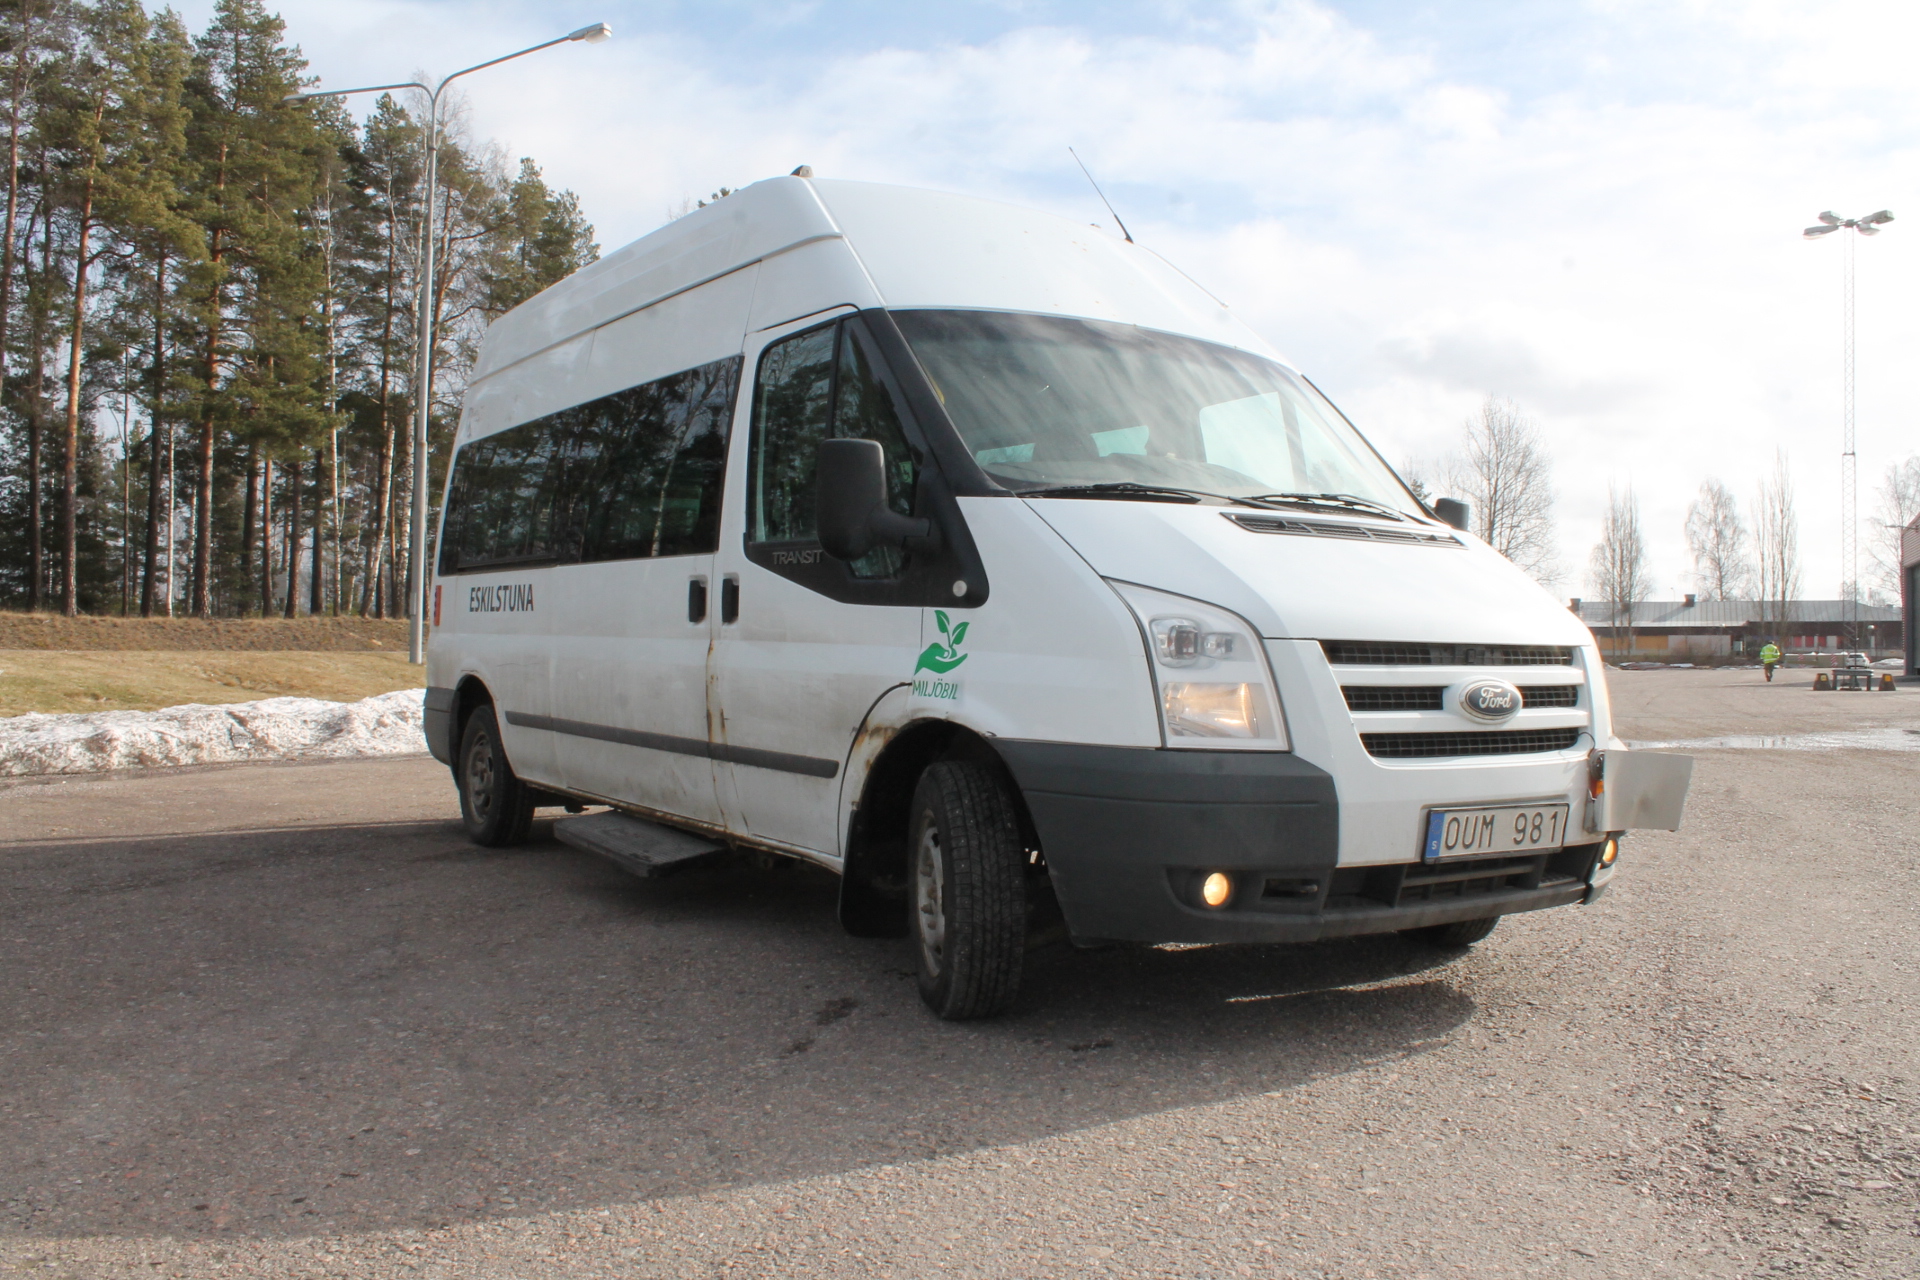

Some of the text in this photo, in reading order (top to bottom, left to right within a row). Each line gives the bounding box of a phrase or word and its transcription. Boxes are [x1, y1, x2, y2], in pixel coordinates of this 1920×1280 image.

[772, 550, 823, 565] TRANSIT
[469, 583, 534, 612] ESKILSTUNA
[912, 678, 958, 700] MILJÖBIL
[1478, 686, 1512, 709] Ford
[1444, 811, 1558, 850] OUM 981
[1431, 840, 1438, 850] S
